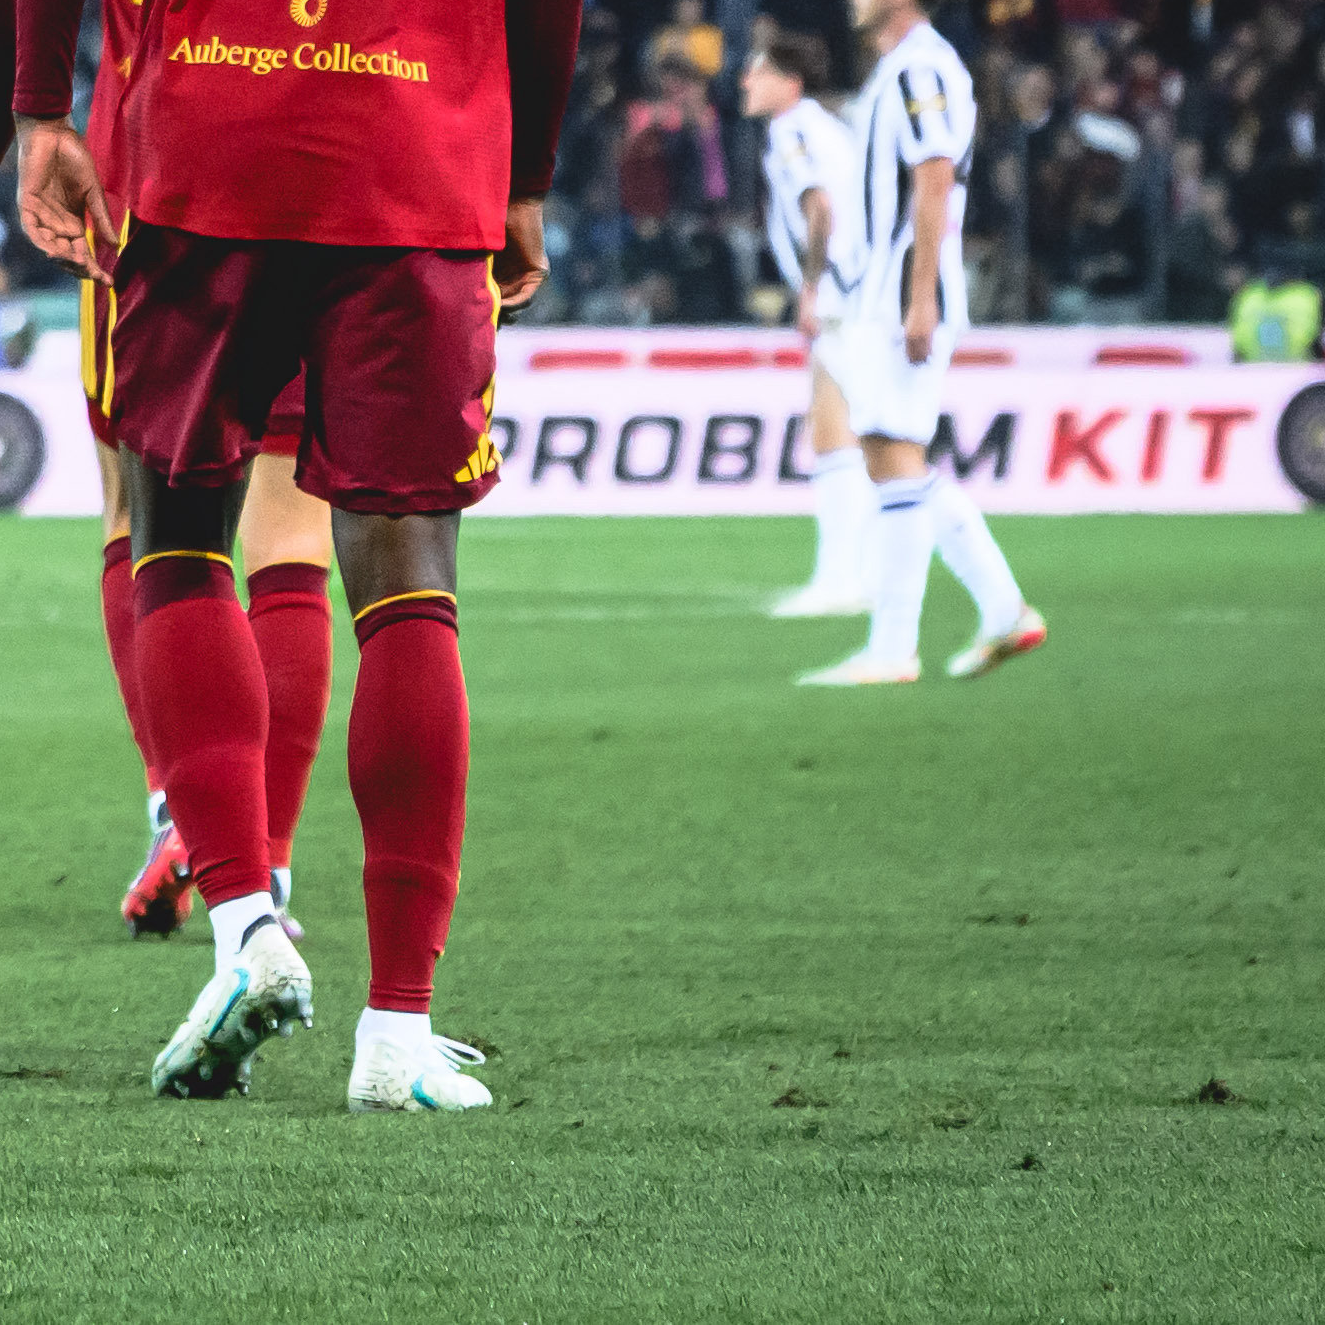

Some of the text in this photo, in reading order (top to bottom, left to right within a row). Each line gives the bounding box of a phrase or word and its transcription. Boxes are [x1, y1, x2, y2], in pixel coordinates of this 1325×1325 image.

[168, 36, 287, 75] Auberge
[293, 42, 430, 82] Collection
[1044, 408, 1256, 485] KIT
